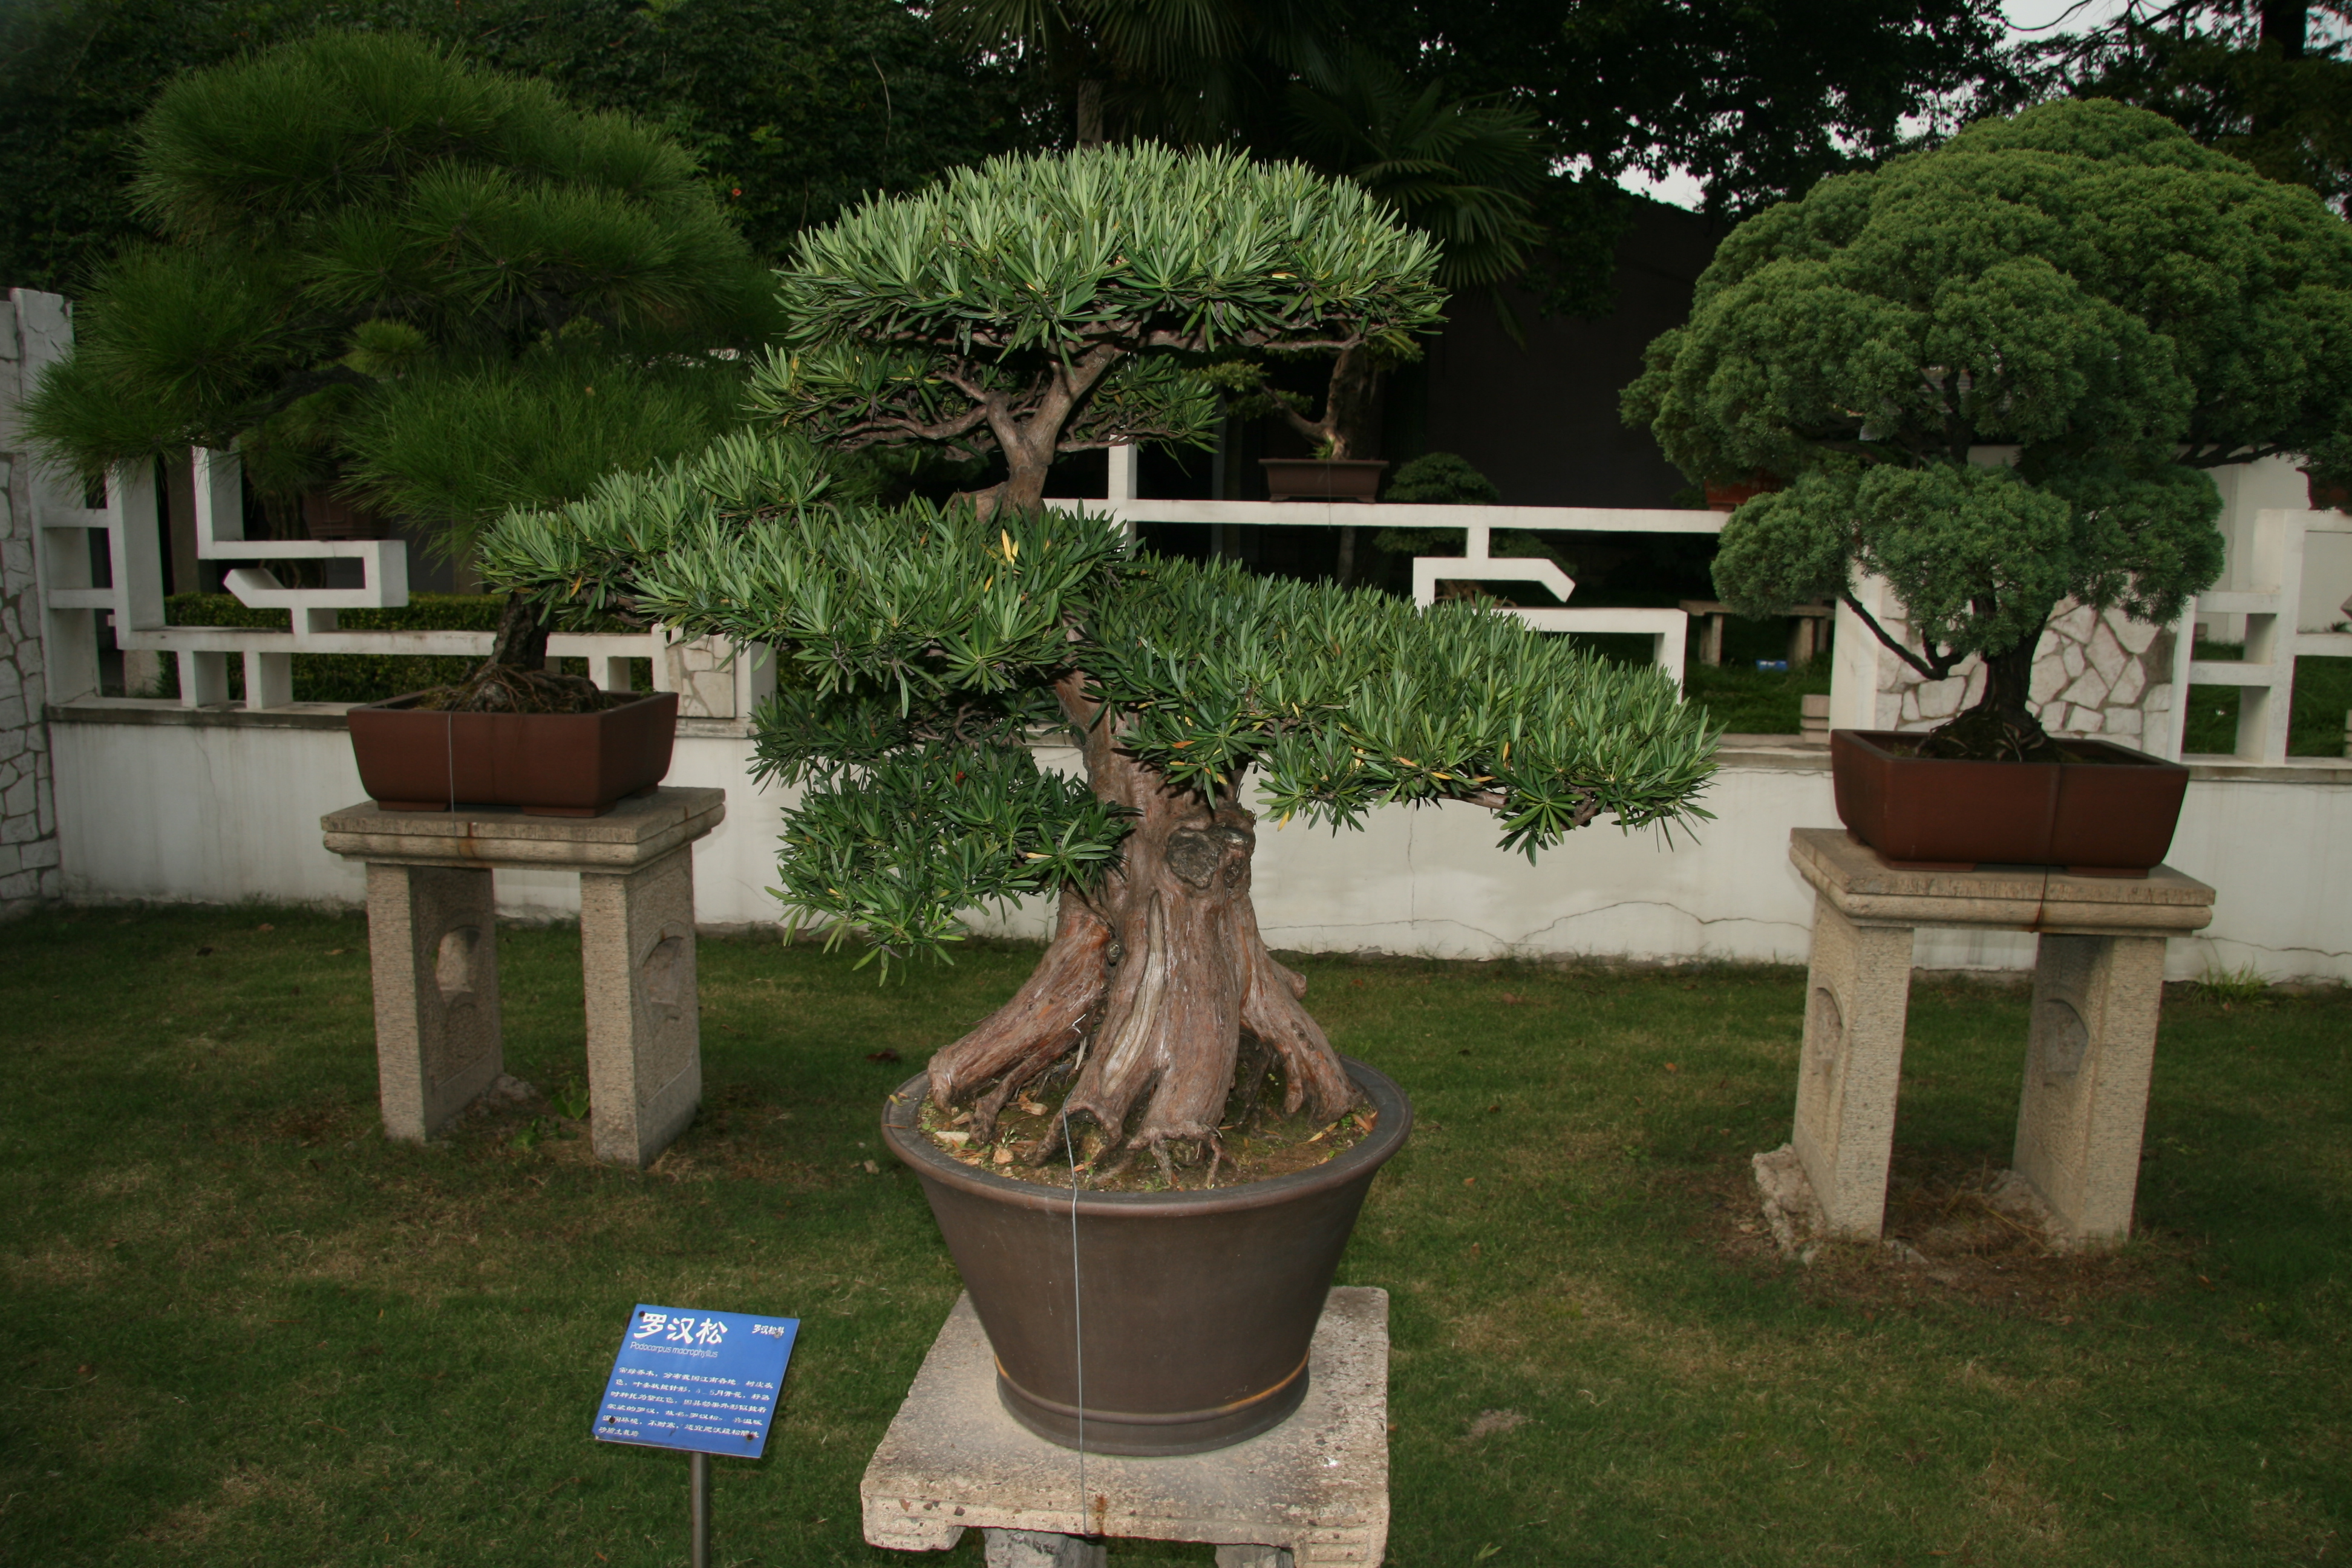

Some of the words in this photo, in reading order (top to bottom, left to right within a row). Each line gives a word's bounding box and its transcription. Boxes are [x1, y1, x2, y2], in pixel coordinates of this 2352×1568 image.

[633, 1313, 728, 1344] 罗汉松
[752, 1324, 785, 1337] 罗汉松科
[630, 1341, 671, 1353] Podocarpus
[672, 1347, 718, 1358] macrophyllus
